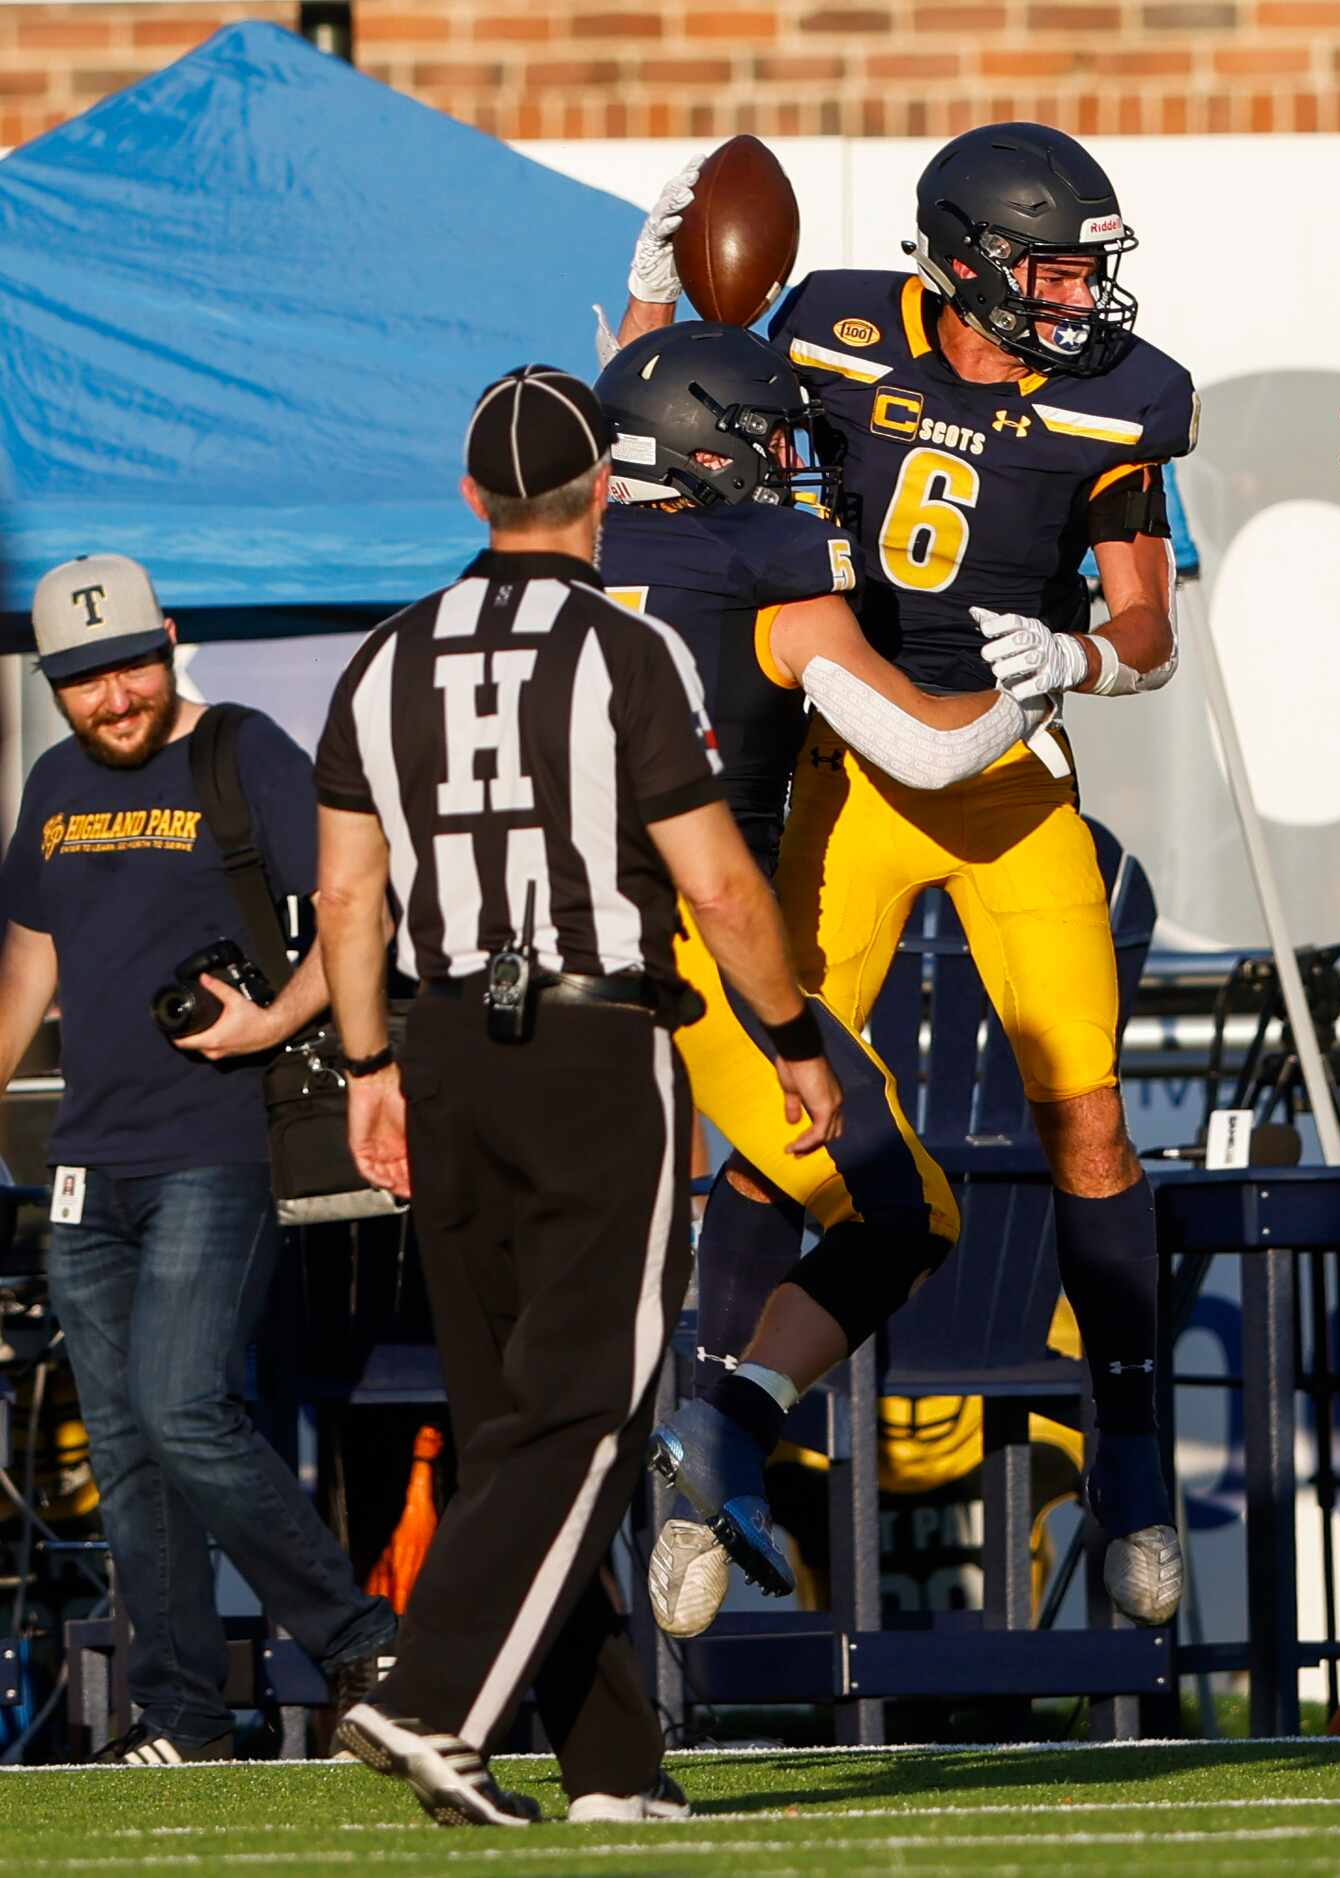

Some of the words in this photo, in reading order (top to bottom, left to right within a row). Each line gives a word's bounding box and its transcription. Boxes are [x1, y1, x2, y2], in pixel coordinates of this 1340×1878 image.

[873, 394, 921, 434] C
[919, 418, 986, 455] SCOTS
[878, 446, 980, 593] 6
[71, 584, 106, 628] T
[433, 649, 539, 816] H
[64, 811, 148, 841] HIGHLAND
[145, 808, 202, 839] PARK
